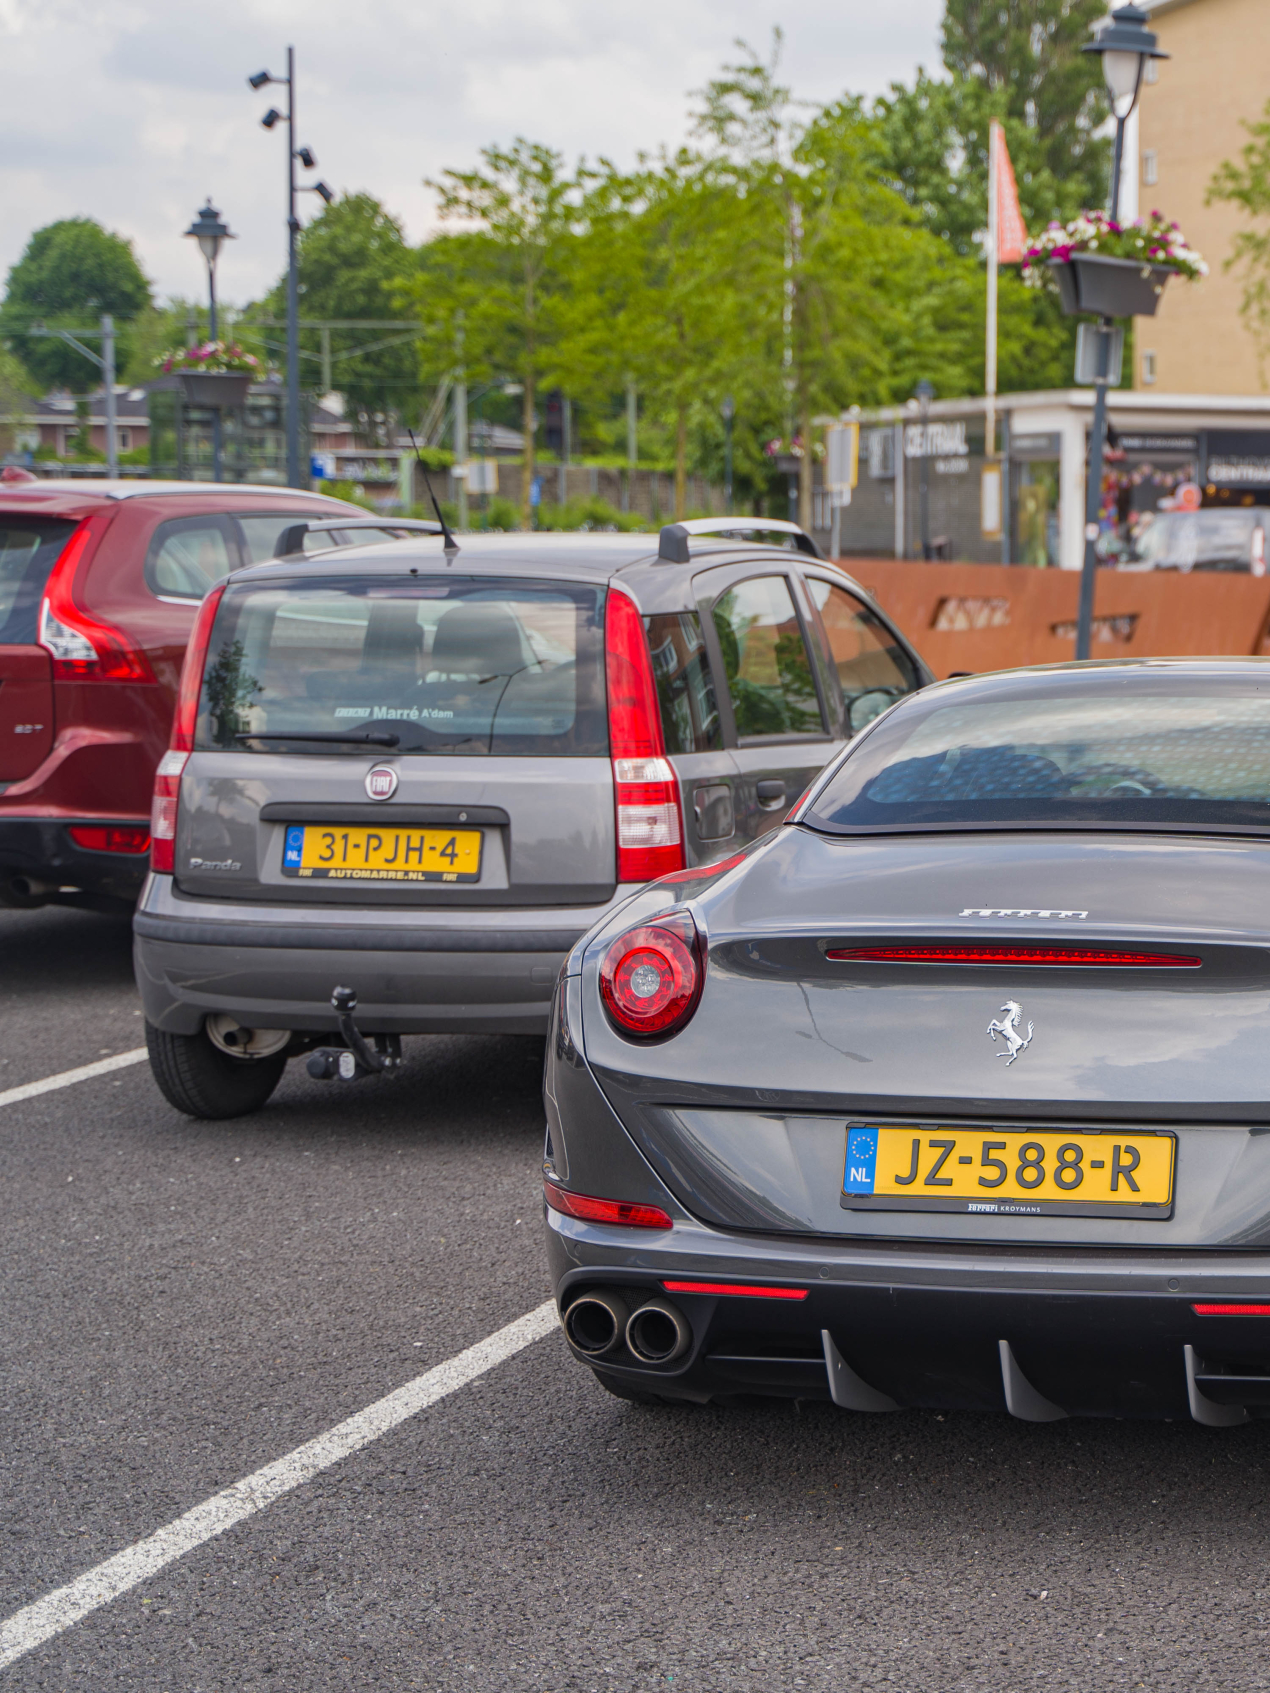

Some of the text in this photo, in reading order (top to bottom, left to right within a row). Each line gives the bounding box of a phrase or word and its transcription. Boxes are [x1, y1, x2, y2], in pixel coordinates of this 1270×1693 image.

[373, 705, 419, 720] Marré
[421, 708, 454, 719] A'dam
[372, 776, 391, 792] FIAT
[287, 851, 300, 861] NL
[318, 832, 459, 866] 31-PJH-4
[188, 857, 242, 871] Panda
[299, 868, 458, 882] FIAT AUTOMARRE.NL FIAT
[894, 1138, 1142, 1192] JZ-588-R
[850, 1166, 871, 1183] NL
[967, 1203, 1041, 1213] Ferrari KROYMANS
